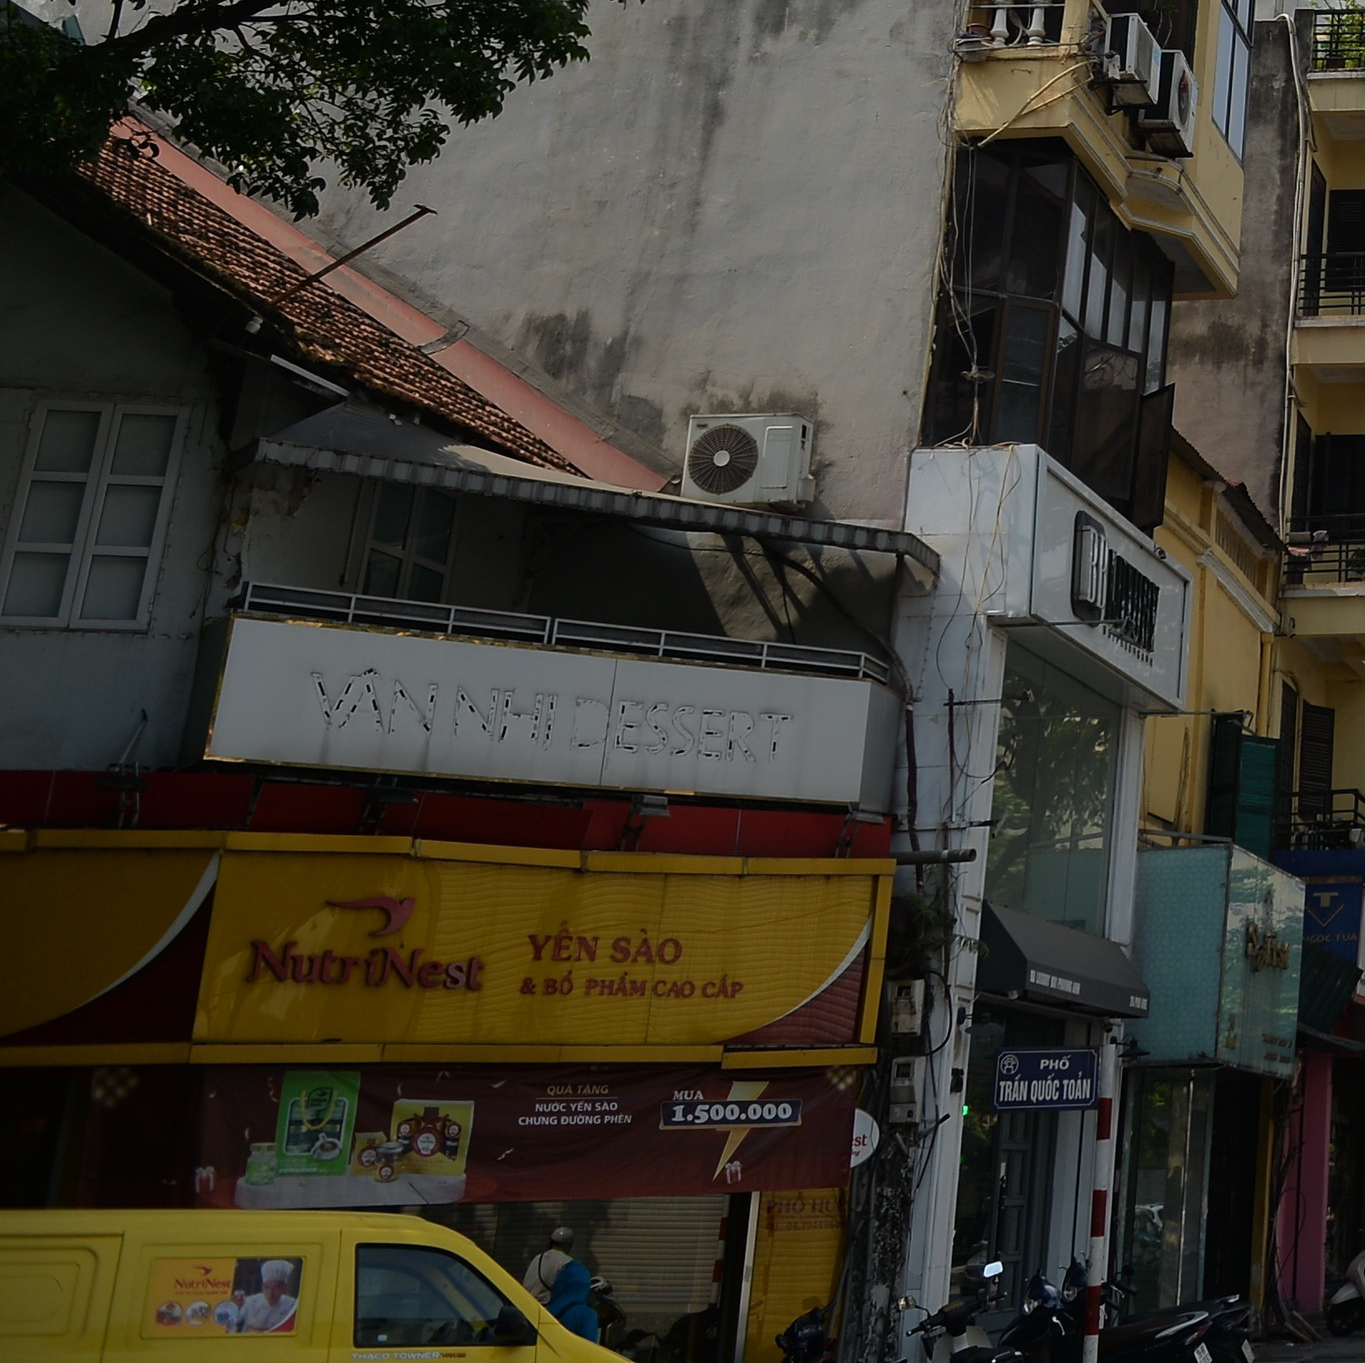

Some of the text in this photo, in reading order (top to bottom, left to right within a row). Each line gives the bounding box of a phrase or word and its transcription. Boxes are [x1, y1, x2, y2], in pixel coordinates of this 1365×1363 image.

[455, 686, 559, 751] NHI
[570, 697, 794, 764] DESSERT
[528, 920, 682, 965] YẾN SÀO
[246, 940, 485, 992] NutriNest
[519, 978, 537, 996] &
[652, 980, 695, 999] CAO
[1039, 1055, 1072, 1071] PHỐ
[546, 1084, 610, 1097] QUÀ TẶNG
[1030, 1072, 1060, 1104] QUỐC
[1062, 1070, 1091, 1101] TOẢN
[672, 1090, 705, 1101] MUA
[535, 1100, 619, 1113] NƯỚC YẾN SÀO
[671, 1102, 793, 1124] 1.500.000
[518, 1112, 633, 1126] CHƯNG ĐƯỜNG PHÈN
[174, 1278, 231, 1290] NutriNest
[393, 1351, 440, 1360] TOWNER
